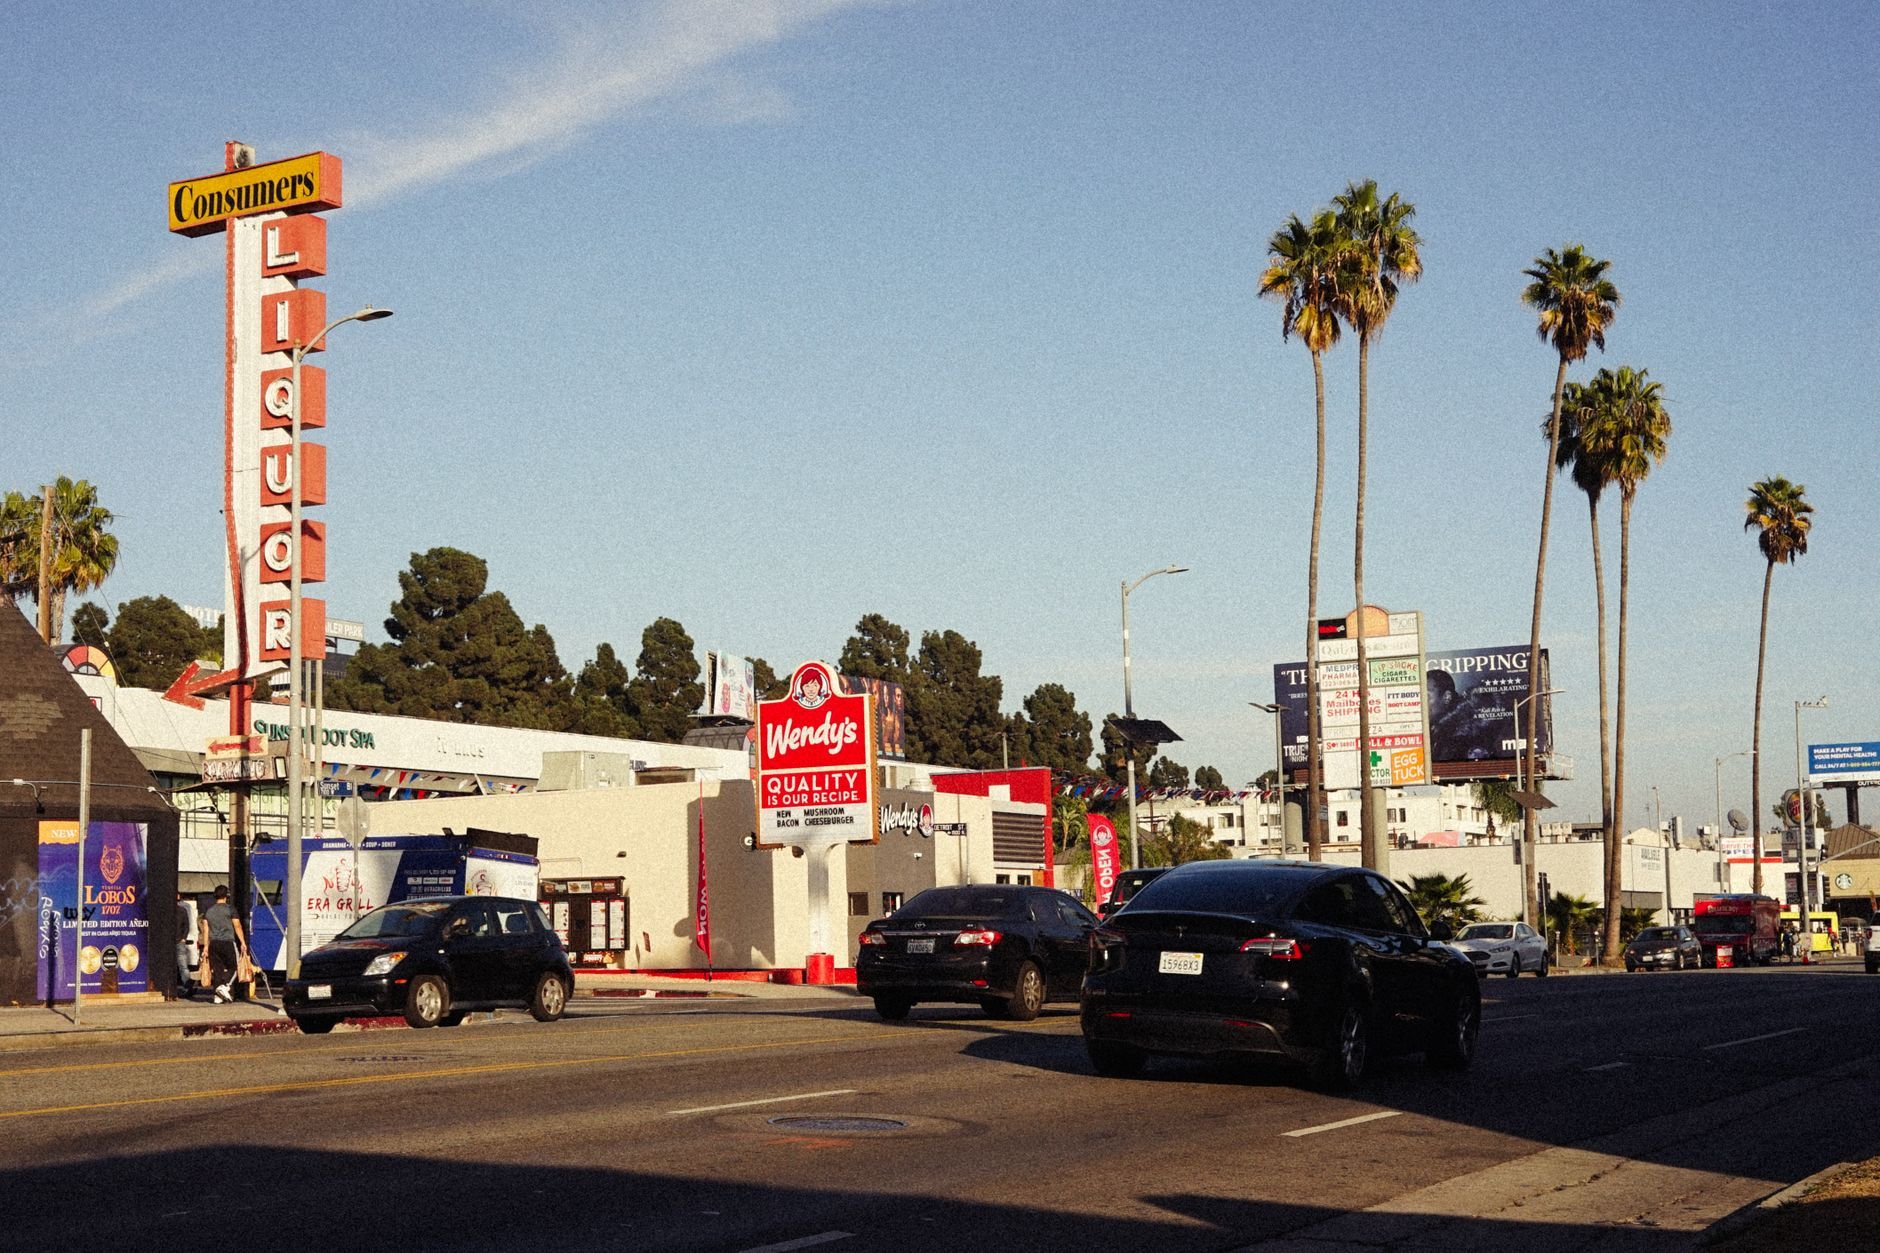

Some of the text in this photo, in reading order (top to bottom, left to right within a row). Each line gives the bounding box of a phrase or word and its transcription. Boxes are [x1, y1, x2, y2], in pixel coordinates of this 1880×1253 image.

[174, 171, 314, 222] Consumers
[264, 226, 299, 651] LIQUOR
[344, 625, 364, 638] PARK
[1390, 661, 1417, 671] SMOKE
[1374, 676, 1417, 684] CIGARETTES
[1336, 691, 1348, 699] 24
[1401, 691, 1420, 699] BODY
[1326, 699, 1381, 709] Mailboes
[350, 728, 376, 750] SPA
[766, 710, 858, 760] Wendy's
[1394, 736, 1422, 746] BOWL
[1283, 745, 1305, 757] TRUE
[1393, 752, 1418, 768] EGG
[1393, 764, 1425, 781] TUCK
[320, 781, 340, 790] Sunset
[767, 772, 858, 795] QUALITY
[767, 796, 778, 806] IS
[782, 793, 808, 804] OUR
[776, 807, 845, 818] NEW MUSHROOM
[881, 802, 918, 835] Wendy's
[776, 816, 854, 828] BACON CHEESEBURGER
[51, 829, 78, 839] NEW
[84, 885, 136, 905] LOBOS
[101, 905, 121, 915] 1707
[307, 897, 374, 911] ERA GRLL
[100, 920, 127, 928] EDITION
[128, 918, 149, 928] AÑEJO
[1162, 960, 1199, 971] 15968X3
